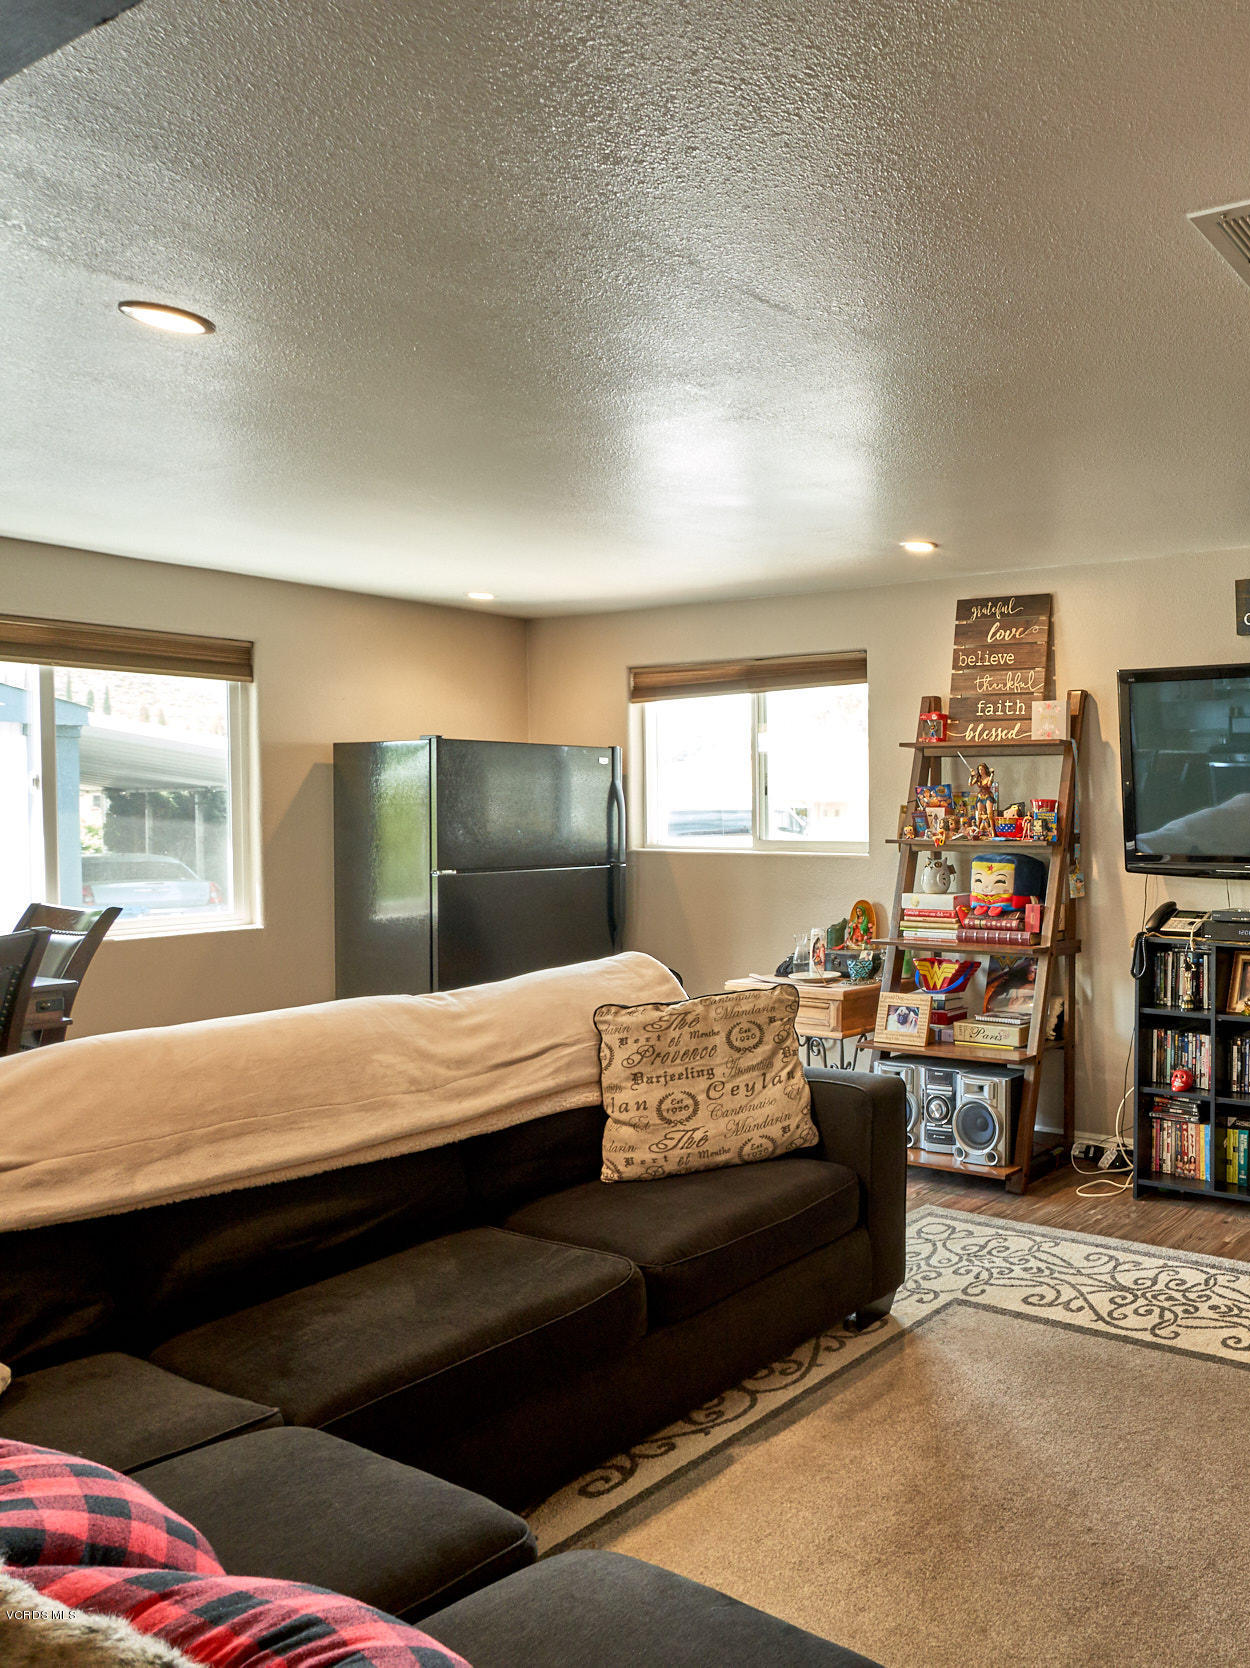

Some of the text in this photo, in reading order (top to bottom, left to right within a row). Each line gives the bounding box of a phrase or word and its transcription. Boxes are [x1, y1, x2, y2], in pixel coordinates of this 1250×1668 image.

[970, 597, 1024, 620] grateful
[987, 622, 1048, 643] love
[958, 650, 1015, 666] believe
[974, 671, 1044, 692] thankful
[976, 700, 1026, 716] faith
[947, 723, 1033, 742] blessed
[714, 1004, 776, 1022] Mandarin
[689, 1028, 720, 1040] Menthe
[969, 1026, 1004, 1042] Paris
[621, 1044, 718, 1069] Provence
[630, 1066, 716, 1091] Darjeeling
[706, 1071, 795, 1100] Ceylan
[670, 1098, 684, 1106] Est
[724, 1112, 792, 1138] Mandarin
[698, 1146, 732, 1159] Menthe
